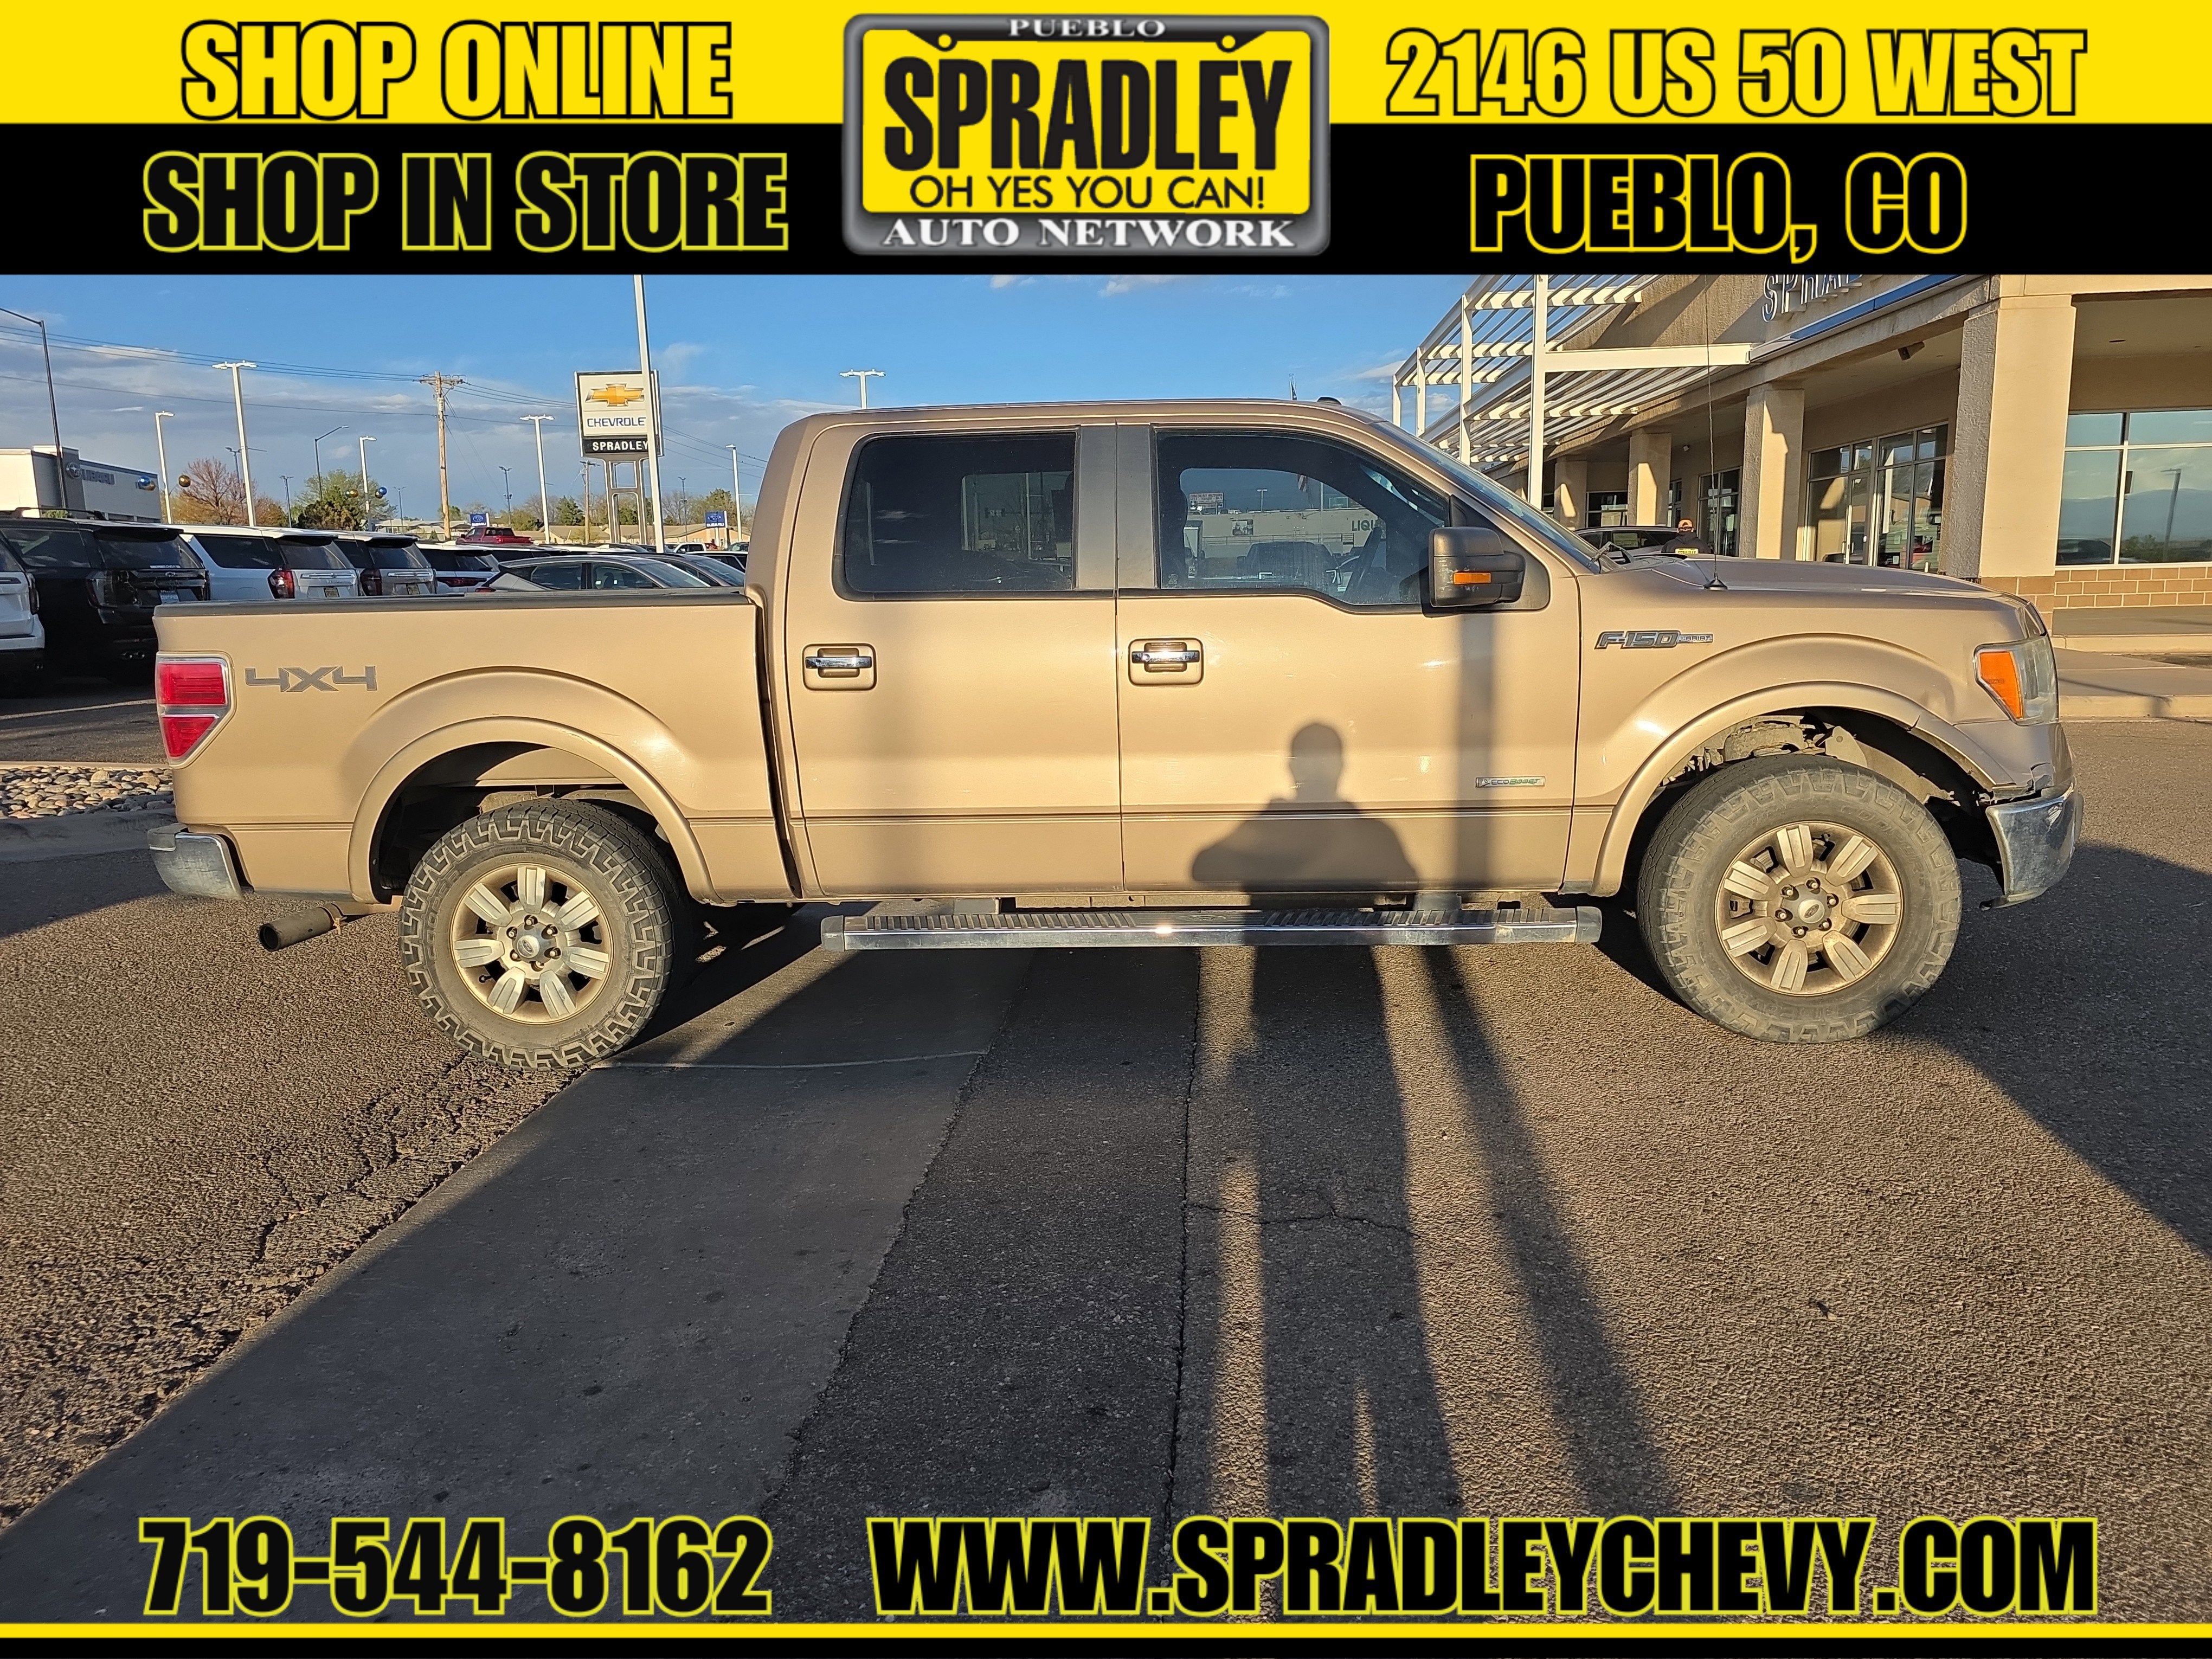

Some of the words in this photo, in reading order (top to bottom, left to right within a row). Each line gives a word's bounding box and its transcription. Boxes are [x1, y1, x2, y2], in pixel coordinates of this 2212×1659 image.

[587, 417, 646, 427] CHEVROLE
[592, 440, 649, 452] SPRADLEY
[1594, 630, 1680, 650] F-150
